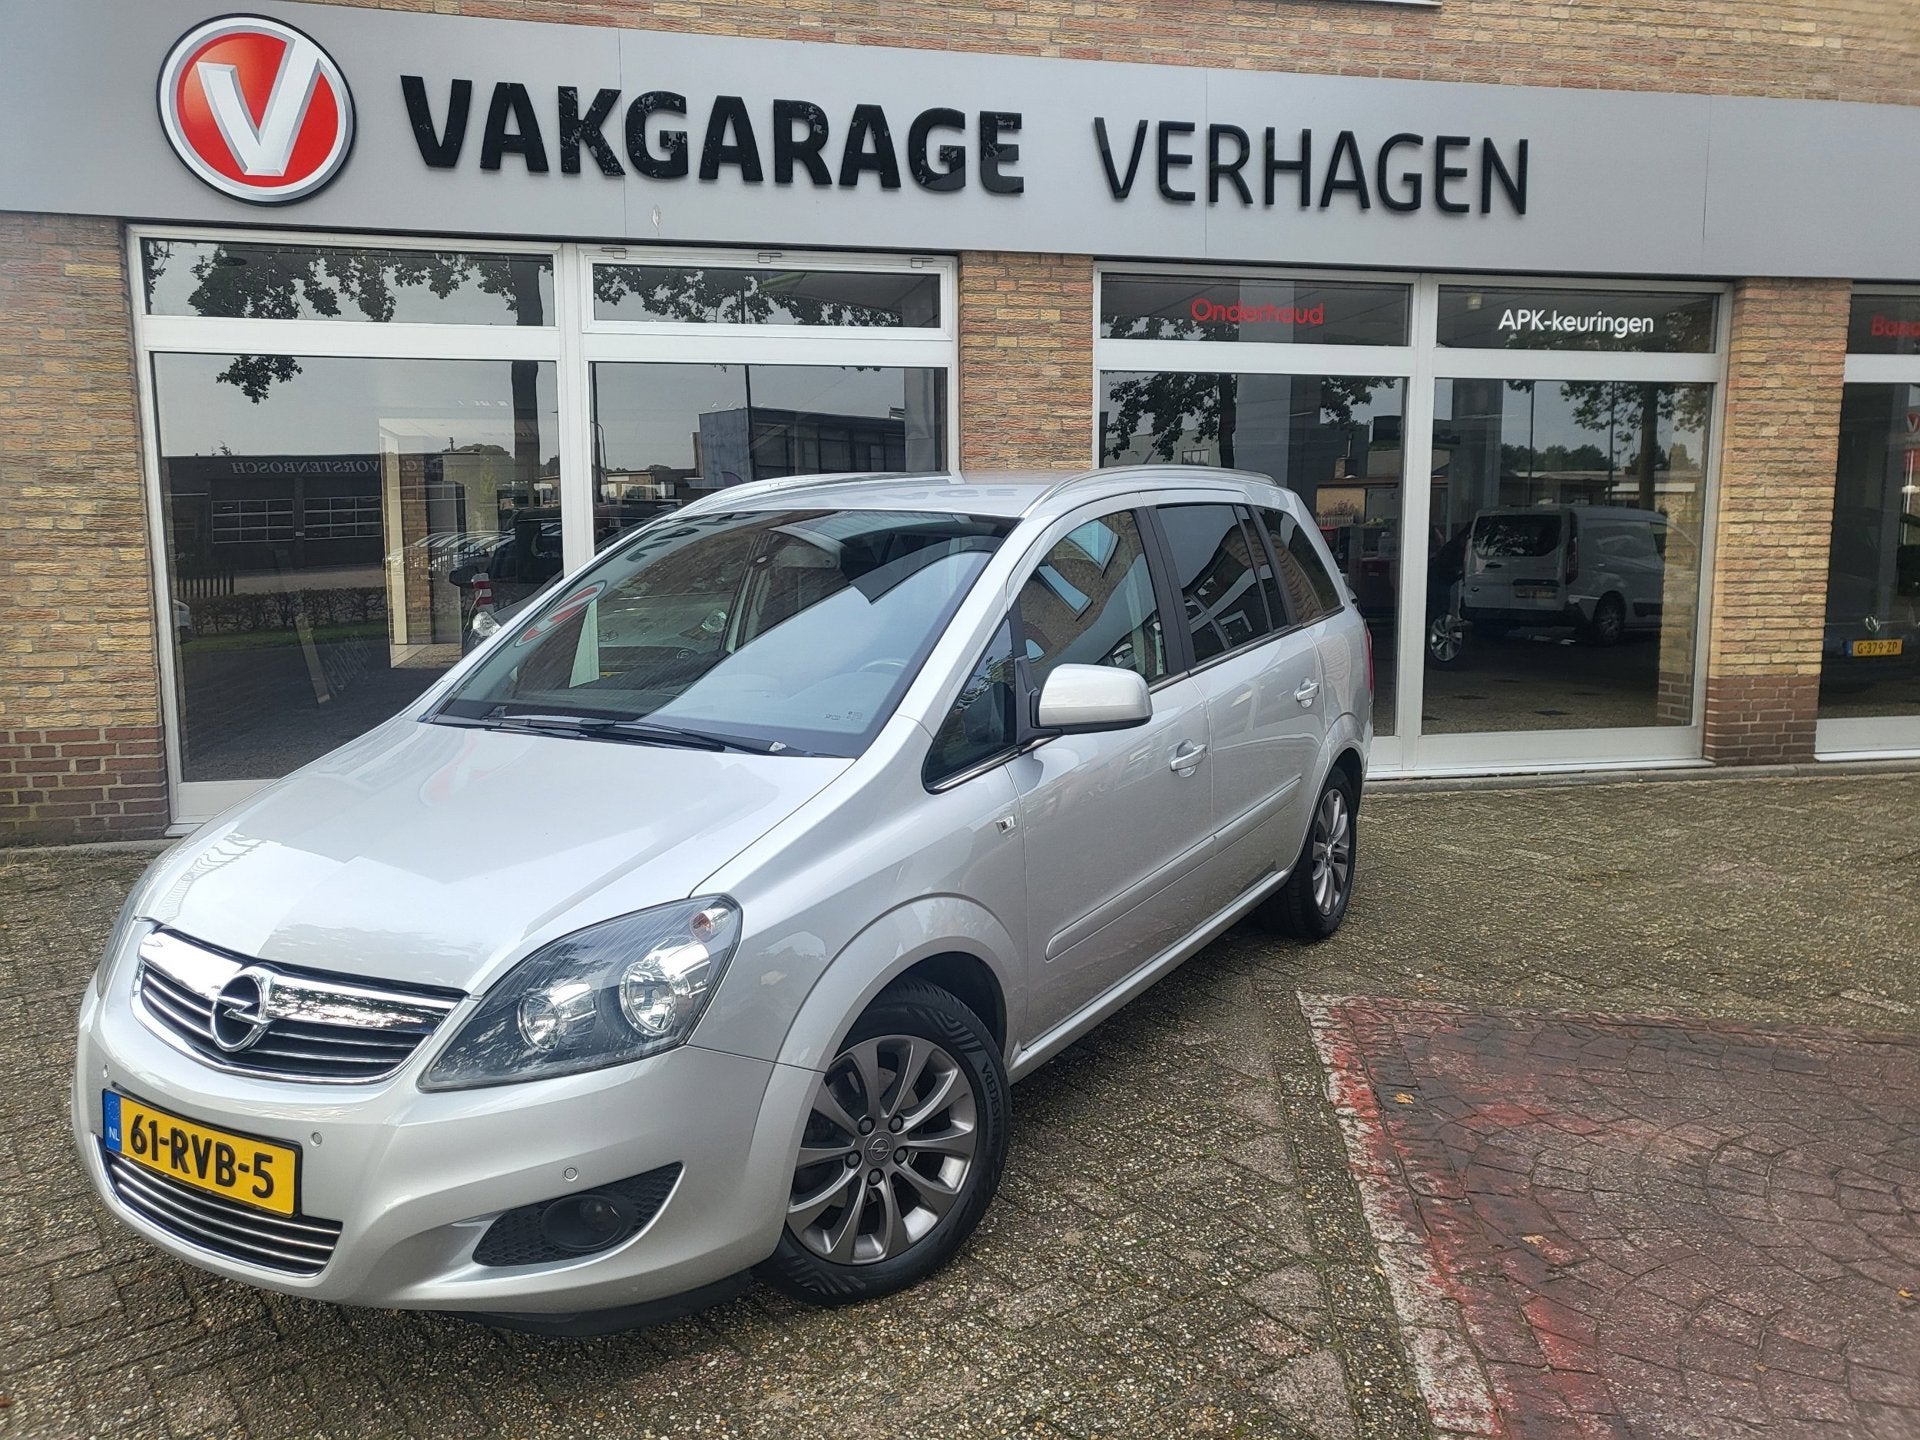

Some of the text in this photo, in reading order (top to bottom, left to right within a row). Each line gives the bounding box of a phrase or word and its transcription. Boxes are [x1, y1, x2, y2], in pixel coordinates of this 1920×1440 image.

[400, 75, 1529, 215] VAKGARAGE VERHAGEN
[1191, 298, 1324, 325] Onderhoud
[1497, 308, 1655, 339] APK-keuringen
[1857, 641, 1898, 655] G-379-ZP
[109, 1126, 120, 1142] NL
[130, 1114, 274, 1199] 61-RVB-5
